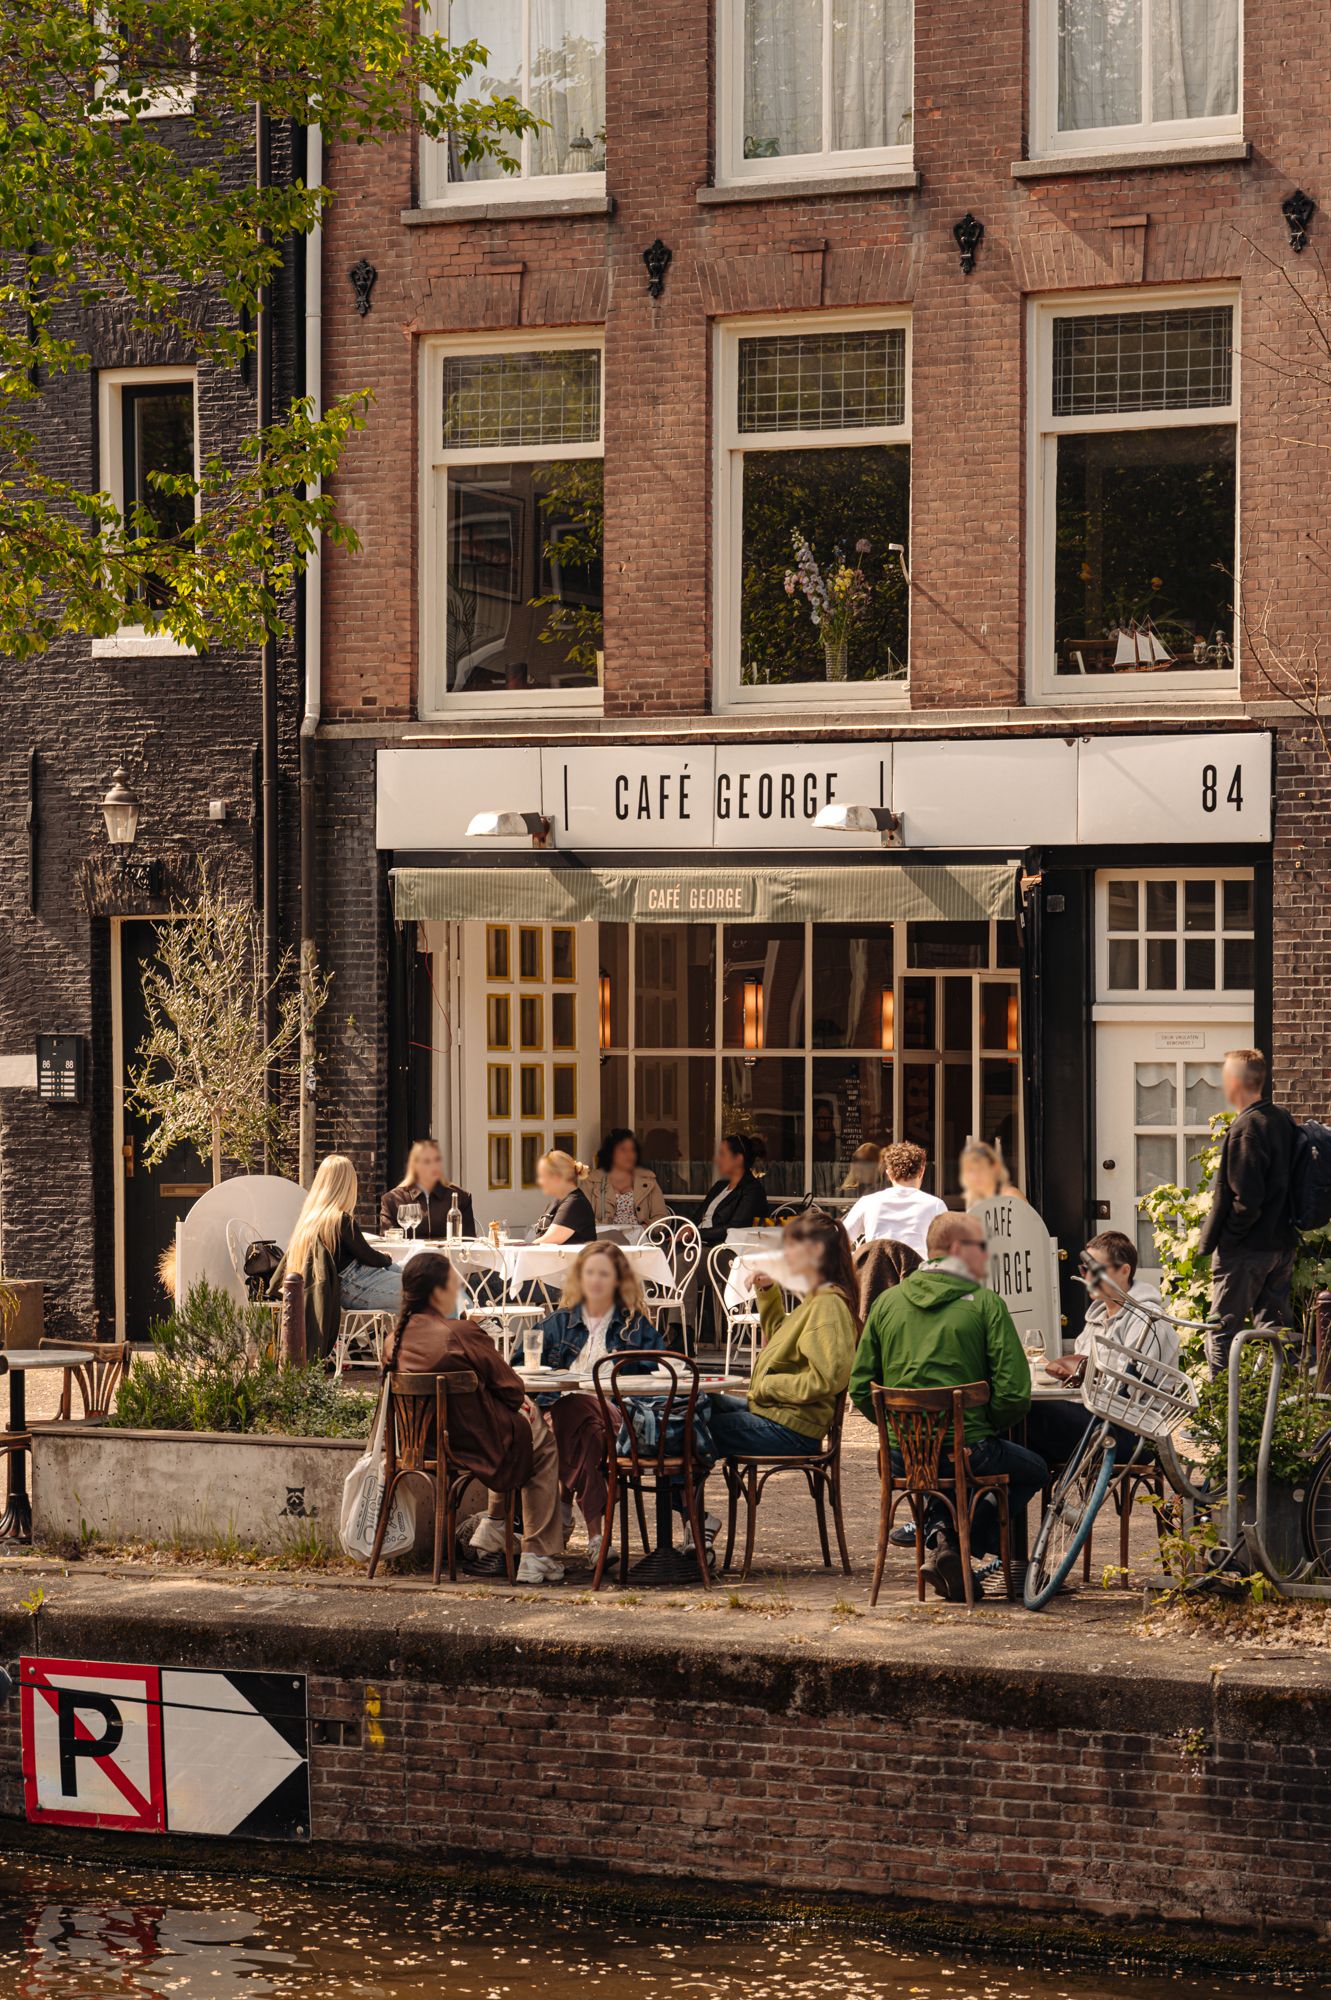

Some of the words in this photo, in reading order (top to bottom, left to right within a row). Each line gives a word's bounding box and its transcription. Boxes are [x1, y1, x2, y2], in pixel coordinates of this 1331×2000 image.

[615, 763, 691, 820] CAFÉ
[716, 773, 838, 819] GEORGE
[1202, 764, 1244, 812] 84
[648, 884, 680, 909] CAFÉ
[690, 887, 742, 909] GEORGE
[42, 1060, 51, 1069] 86
[65, 1060, 74, 1069] 88
[991, 1250, 1033, 1296] ORGE
[58, 1690, 123, 1798] P
